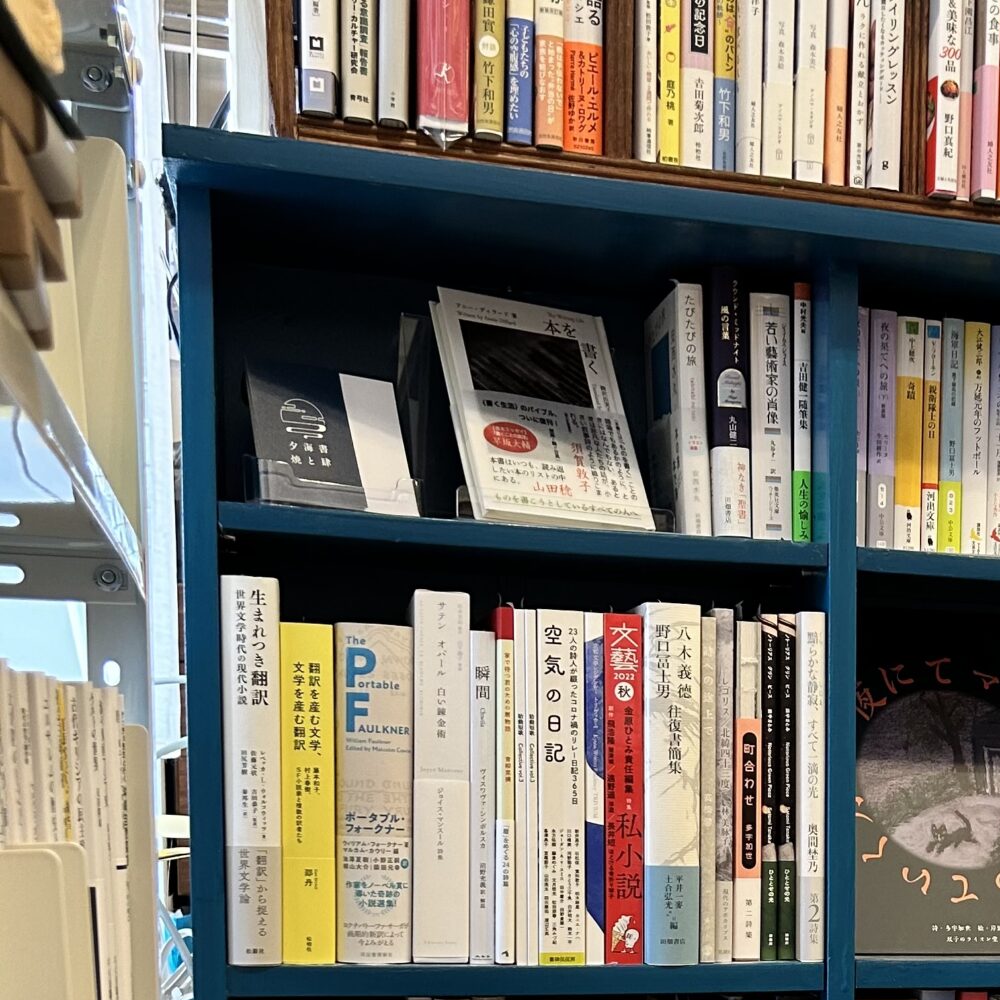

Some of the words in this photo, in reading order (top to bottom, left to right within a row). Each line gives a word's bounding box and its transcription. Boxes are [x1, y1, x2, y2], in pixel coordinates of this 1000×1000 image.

[483, 60, 494, 114] 竹下和男
[587, 52, 599, 134] ピエール・エルメ
[718, 88, 730, 141] 竹下和男
[685, 295, 696, 367] たびたびの旅
[765, 322, 779, 425] 若い藝術家の肖像
[799, 362, 807, 430] 吉田健一随筆集
[972, 384, 982, 476] 万延元年のフットボール
[571, 443, 590, 492] 須賀敦子
[799, 478, 808, 540] 人生の愉しみ
[926, 492, 934, 530] 河出文庫
[236, 590, 248, 705] 世界文学時代の現代小説
[250, 589, 268, 706] 生まれつき翻訳
[346, 636, 366, 645] The
[609, 623, 638, 671] 文藝
[678, 625, 692, 699] 八木義徳
[293, 662, 306, 750] 文学を産む翻訳
[475, 666, 490, 699] 瞬間
[544, 625, 565, 762] 空気の日記
[618, 685, 631, 698] 秋
[624, 707, 633, 794] 金原ひとみ責任編集
[668, 706, 682, 774] 往復書簡集
[239, 849, 250, 904] 世界文学論
[617, 814, 642, 899] 私小説
